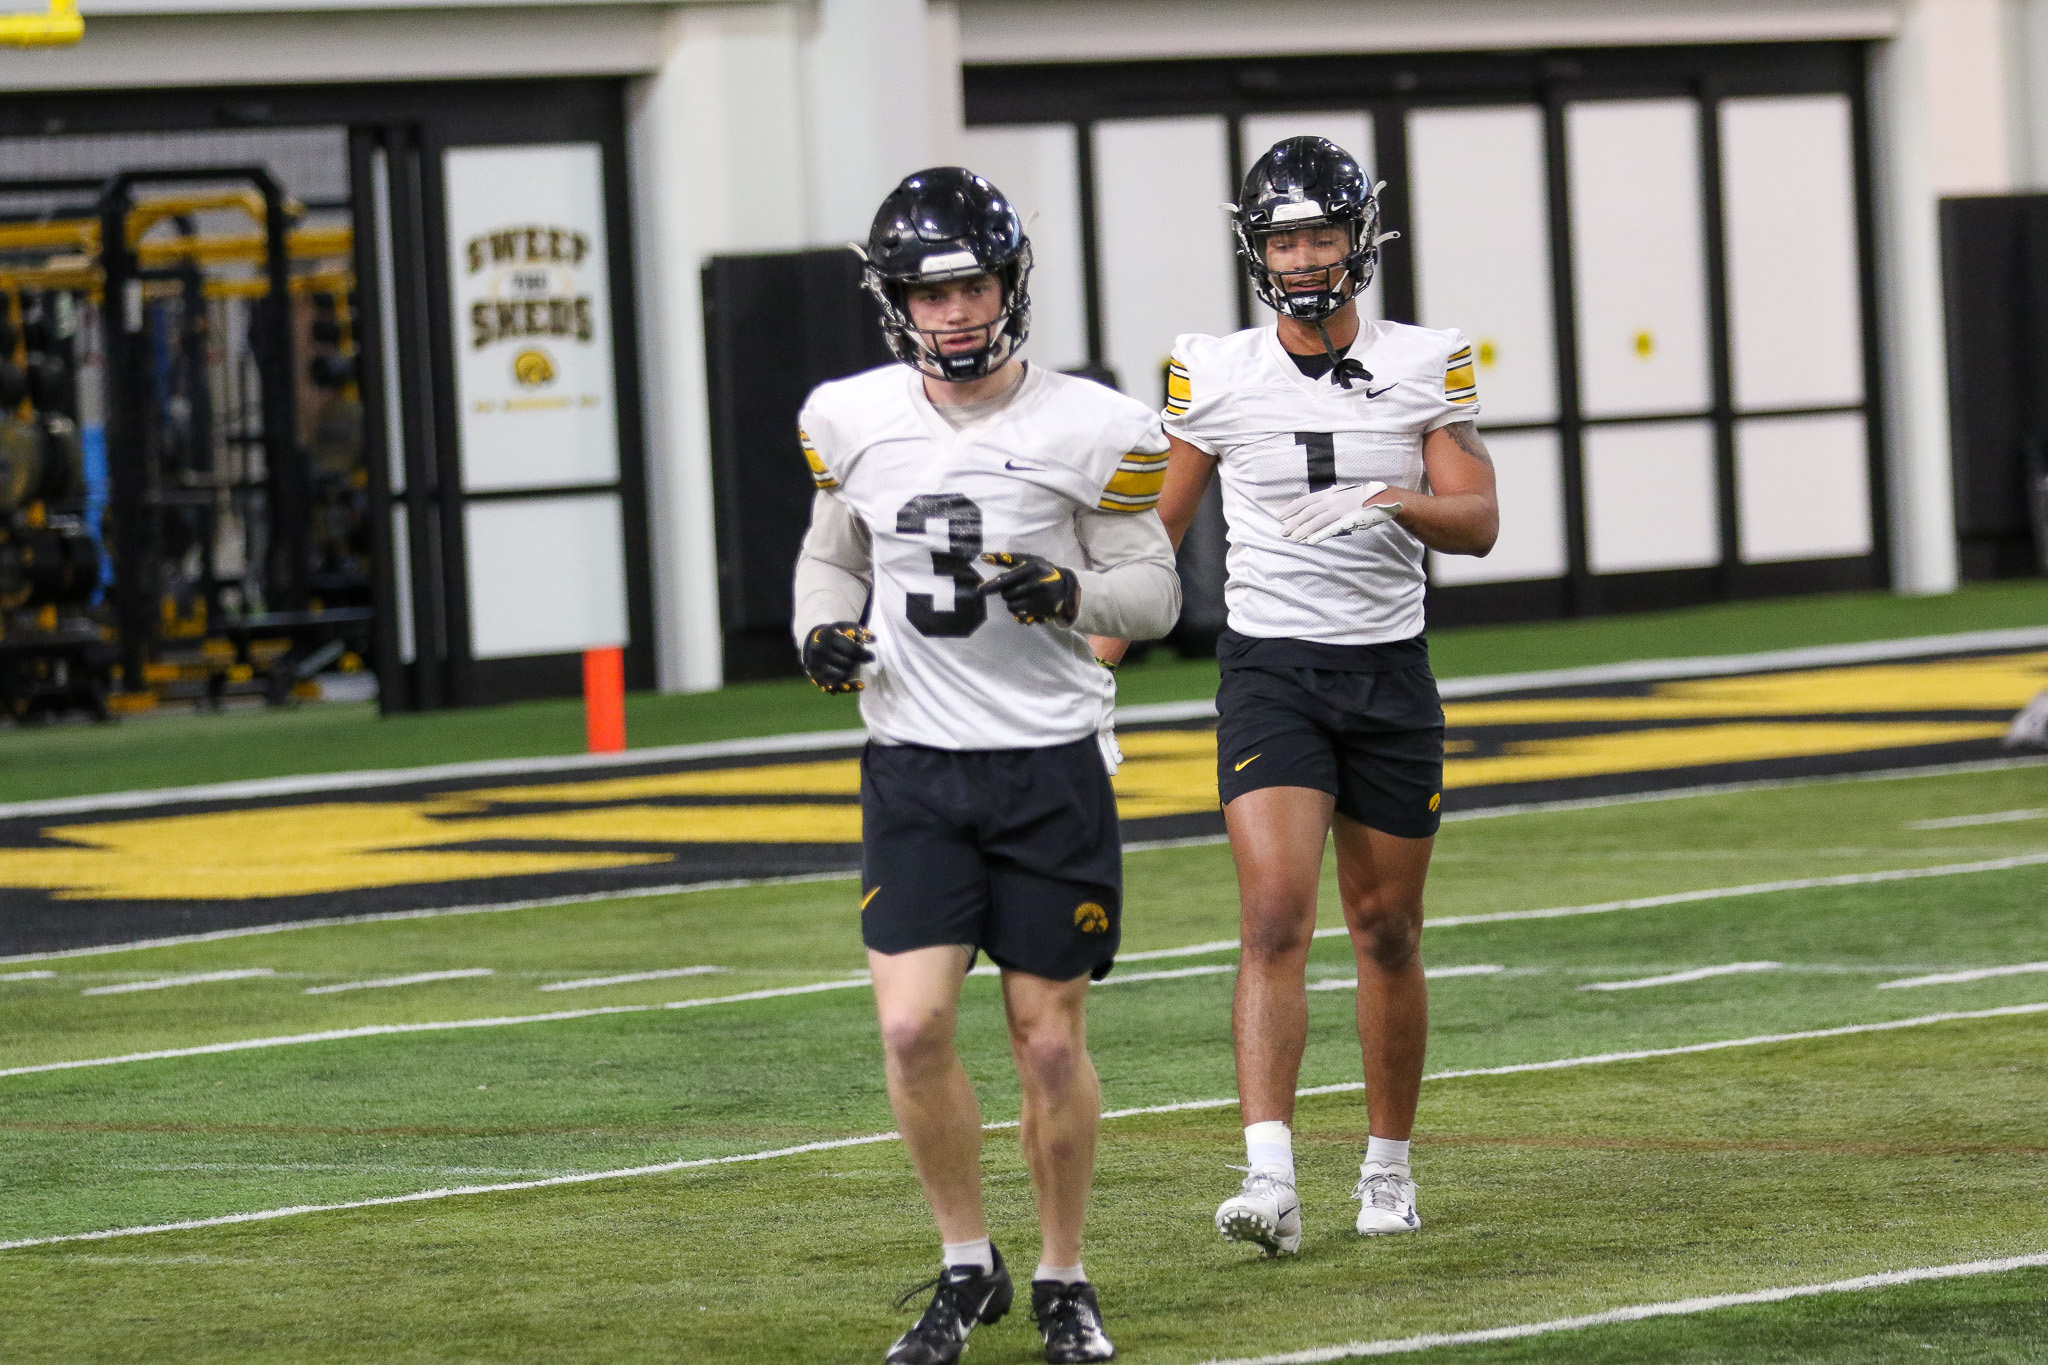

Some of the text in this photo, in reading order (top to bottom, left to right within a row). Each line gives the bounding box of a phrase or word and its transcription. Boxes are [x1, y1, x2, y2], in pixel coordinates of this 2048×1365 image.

[951, 358, 975, 367] Riddell
[1294, 431, 1338, 494] 1
[895, 492, 988, 639] 3
